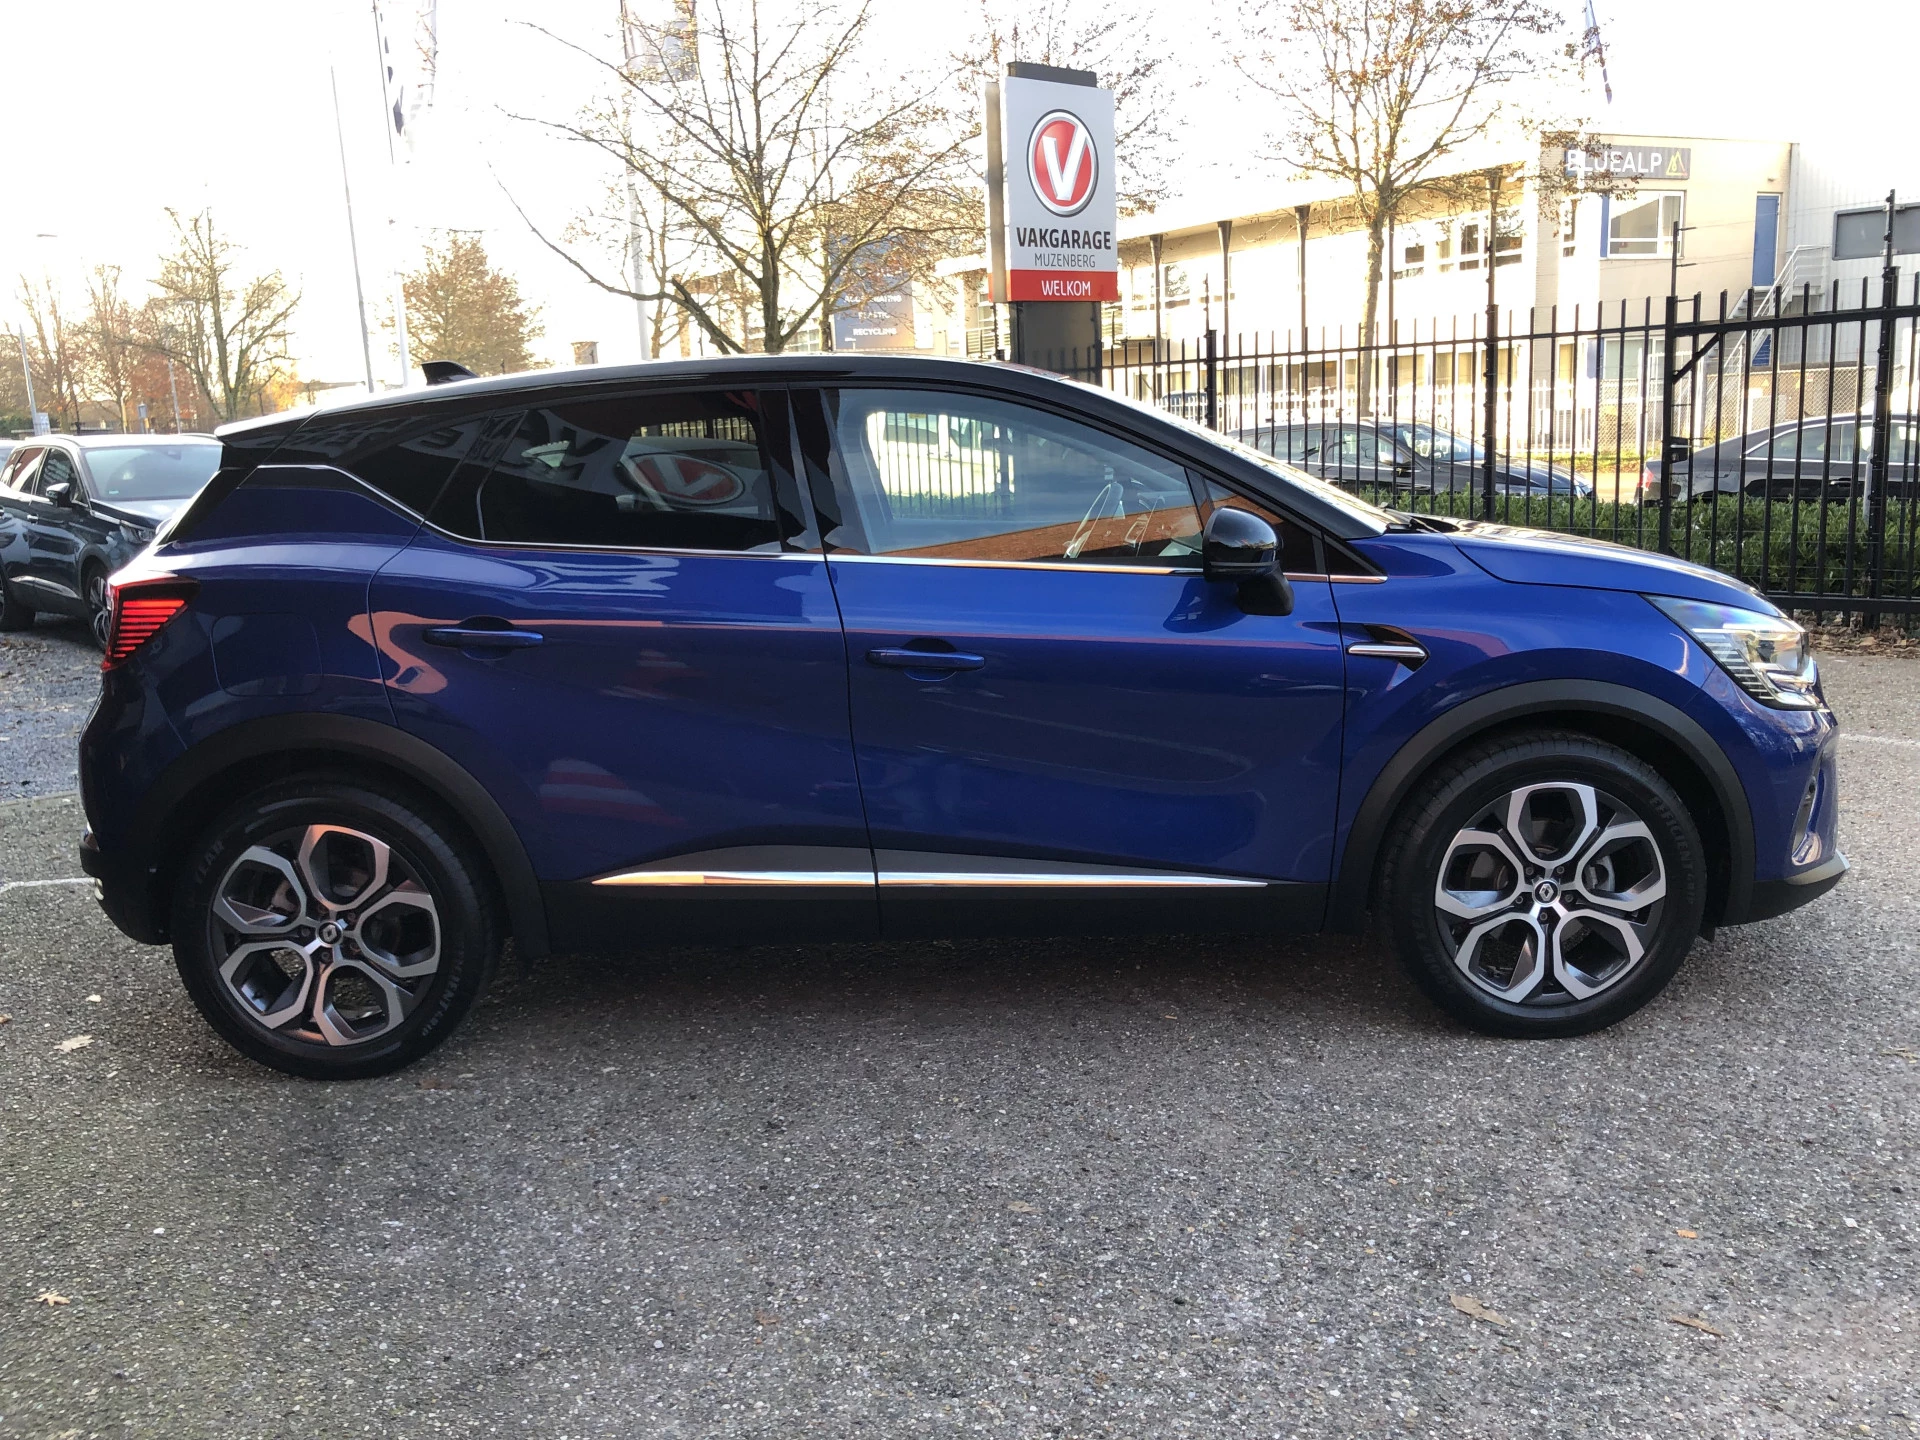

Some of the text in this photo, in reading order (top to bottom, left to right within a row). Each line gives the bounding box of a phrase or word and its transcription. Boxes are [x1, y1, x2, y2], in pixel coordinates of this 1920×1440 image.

[1041, 119, 1089, 202] V
[1016, 226, 1112, 250] VAKGARAGE
[1034, 252, 1096, 268] MUZENBERG
[1041, 279, 1091, 297] WELKOM
[853, 327, 897, 336] RECYCLING
